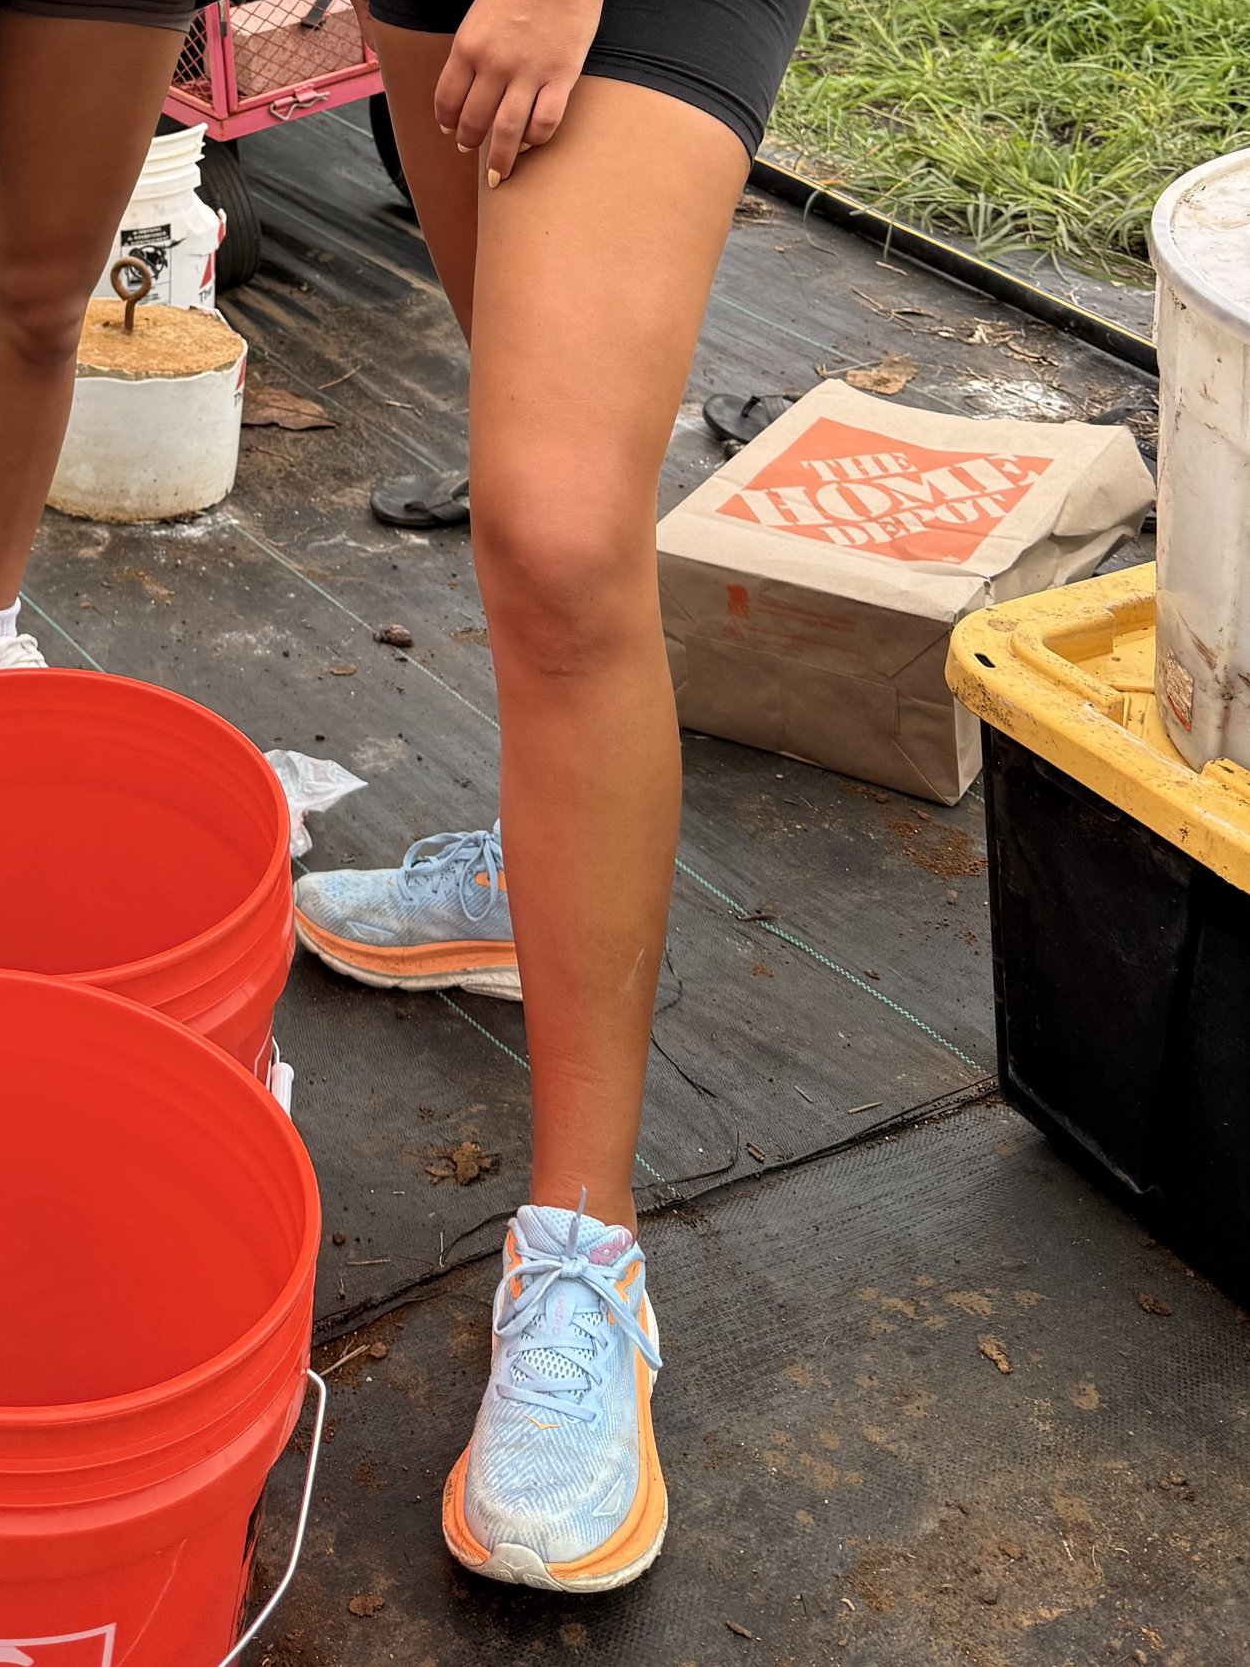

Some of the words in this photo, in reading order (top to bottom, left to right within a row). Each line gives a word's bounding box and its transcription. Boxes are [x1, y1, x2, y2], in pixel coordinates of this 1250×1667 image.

[733, 452, 1043, 529] HOME
[800, 452, 919, 483] THE
[818, 494, 1007, 547] DEPOT
